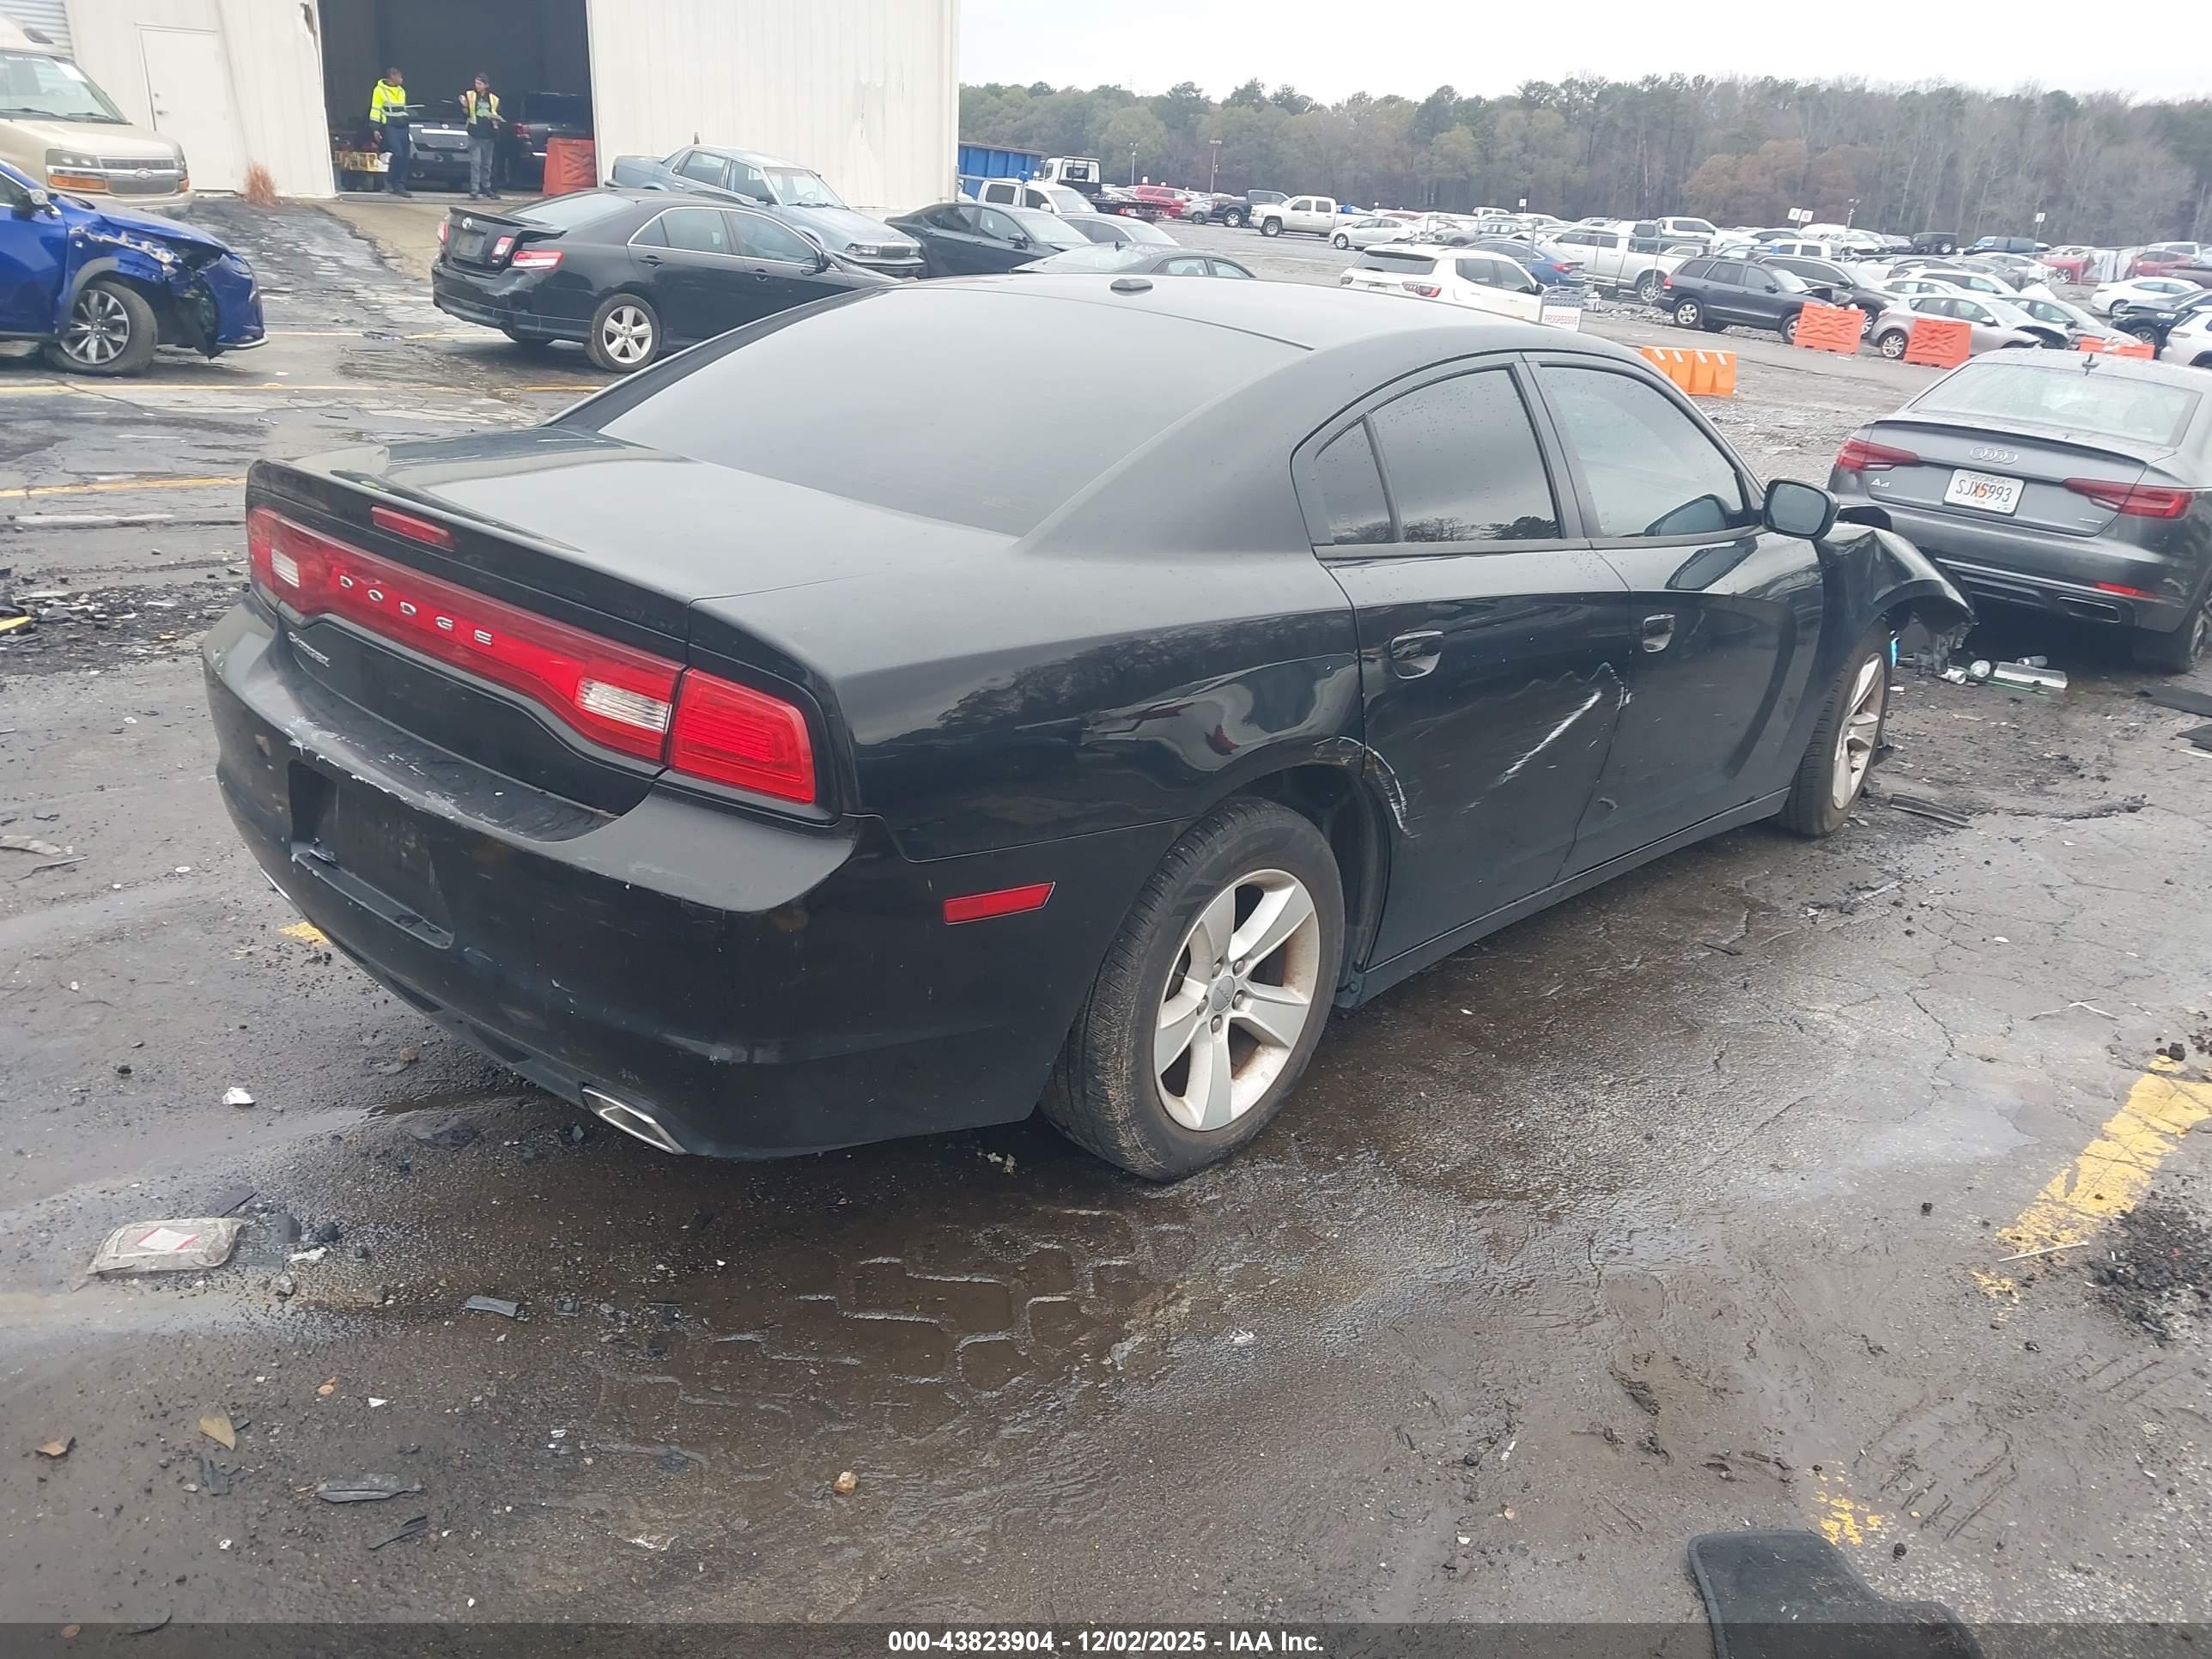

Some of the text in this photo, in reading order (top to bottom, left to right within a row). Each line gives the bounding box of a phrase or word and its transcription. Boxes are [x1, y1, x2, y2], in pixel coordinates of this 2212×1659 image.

[1870, 477, 1890, 488] A4
[1956, 479, 2013, 502] SJX5993
[339, 574, 493, 646] DODGE
